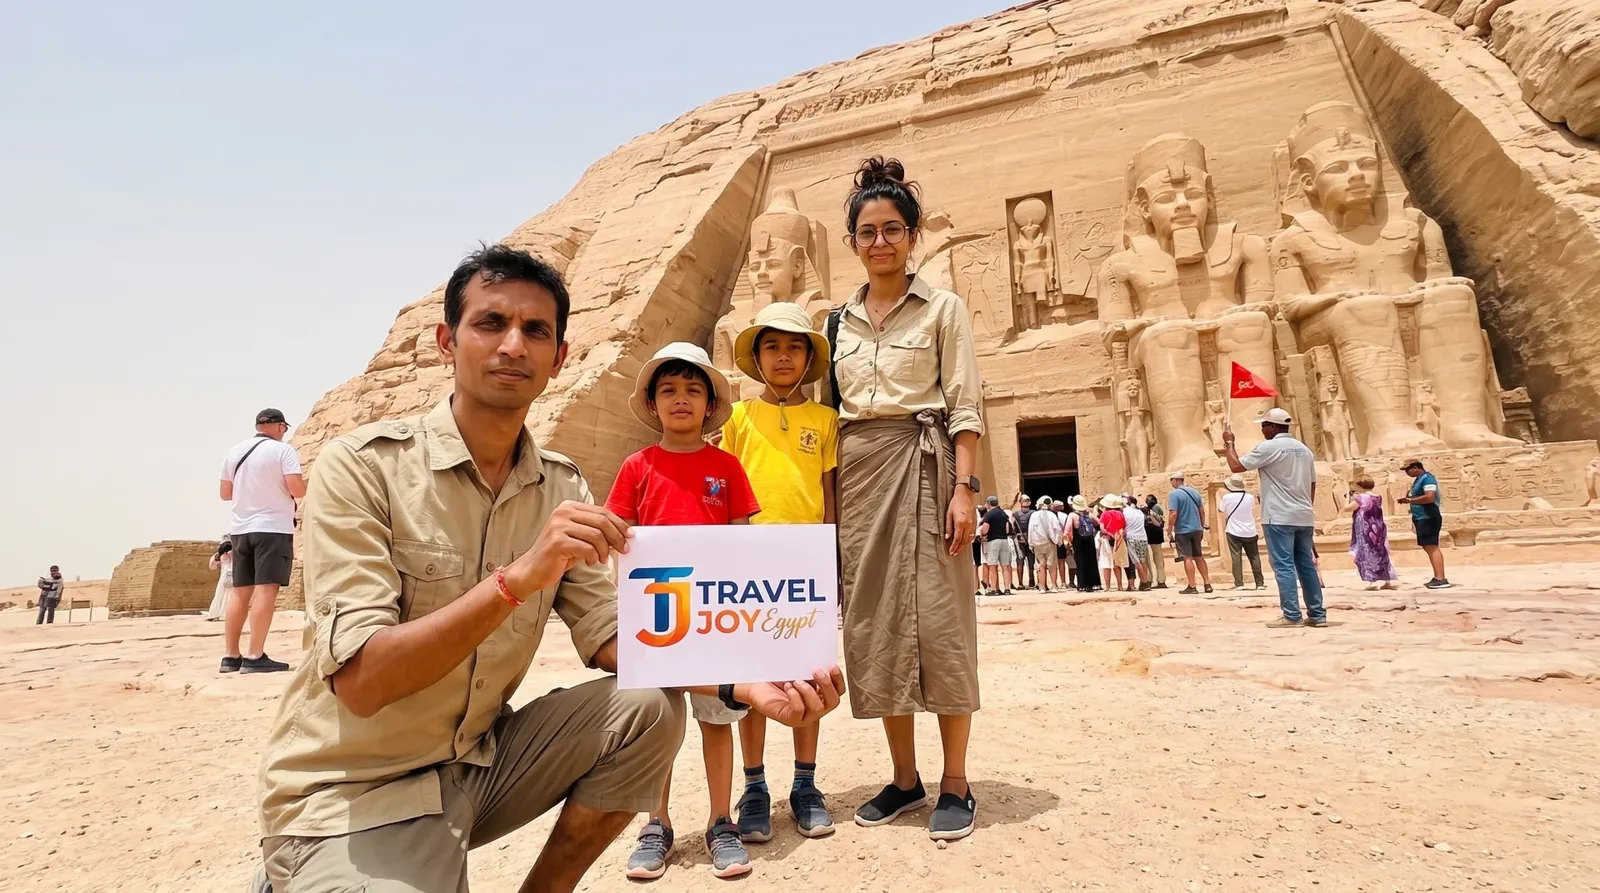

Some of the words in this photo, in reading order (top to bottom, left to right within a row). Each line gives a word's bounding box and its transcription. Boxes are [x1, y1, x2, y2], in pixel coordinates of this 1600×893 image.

[696, 578, 826, 604] TRAVEL
[696, 609, 762, 634] JOY
[761, 607, 824, 639] Egypt
